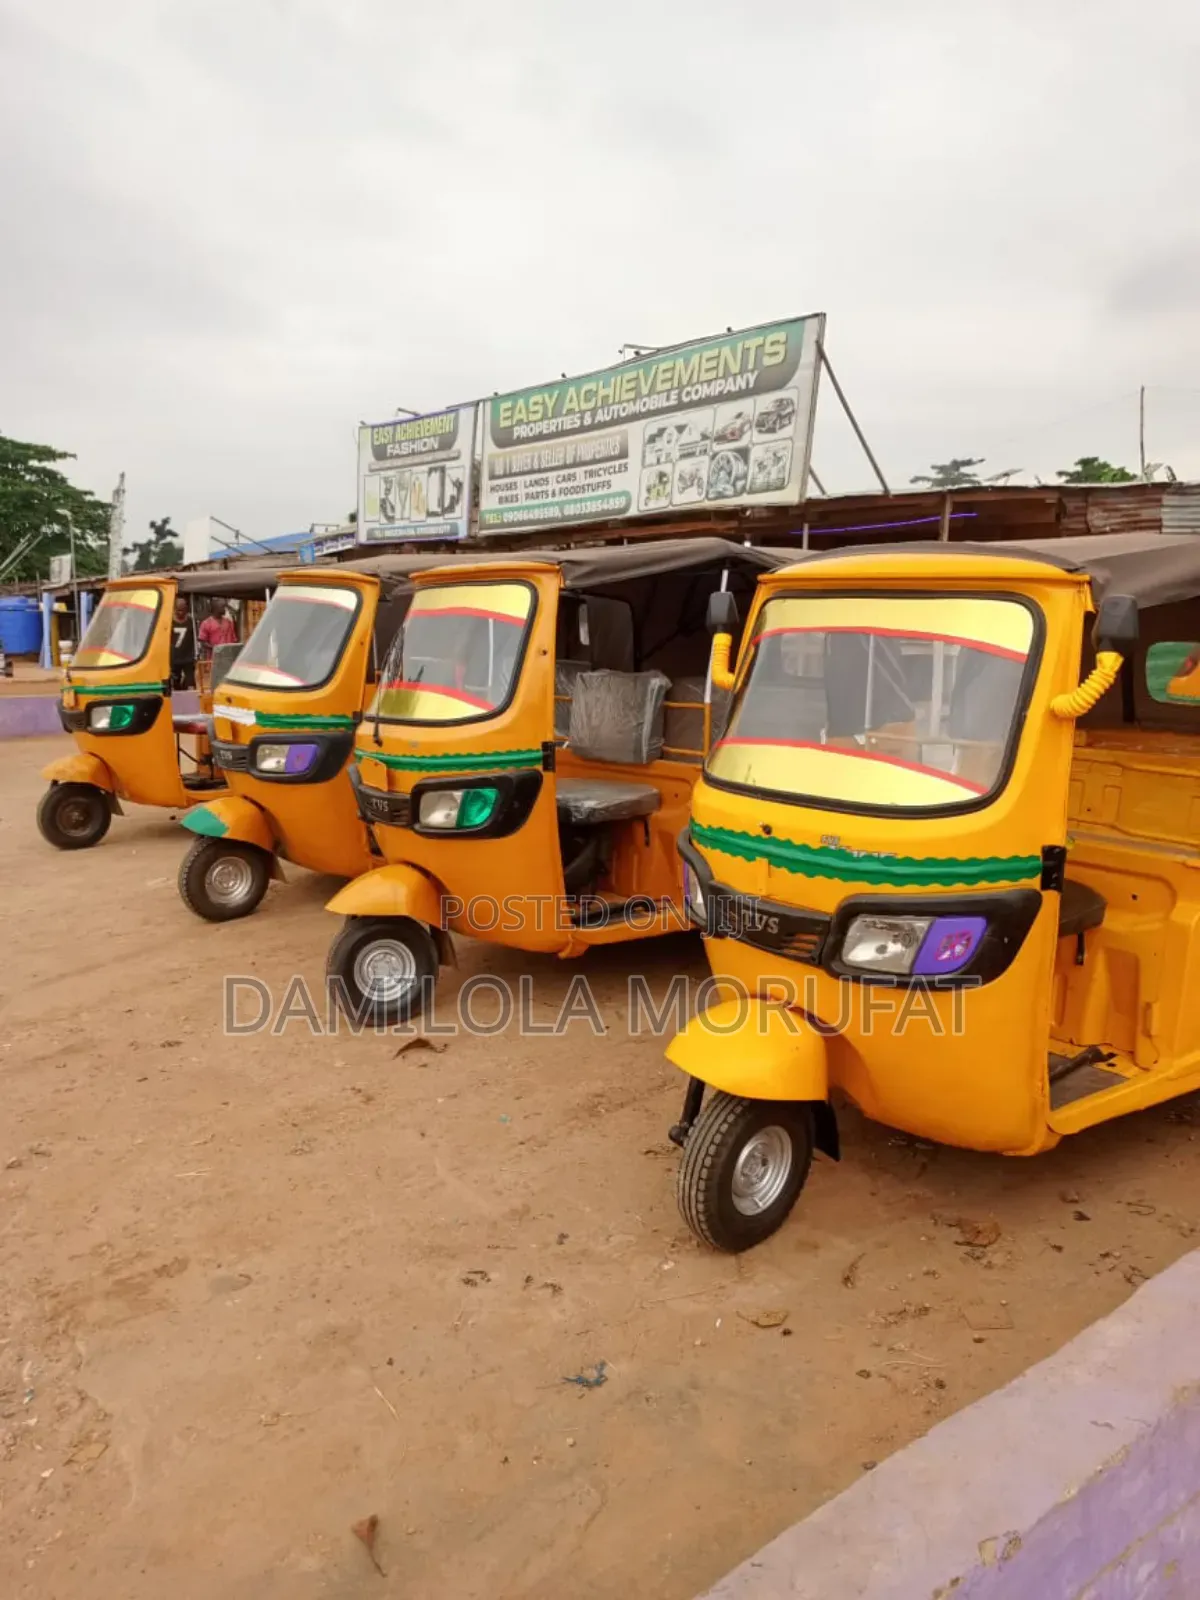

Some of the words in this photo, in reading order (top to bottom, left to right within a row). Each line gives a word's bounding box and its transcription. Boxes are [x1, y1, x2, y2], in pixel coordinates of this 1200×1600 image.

[499, 390, 560, 428] EASY
[563, 331, 788, 415] ACHIEVEMENTS
[513, 412, 581, 440] PROPERTIES
[583, 411, 593, 426] &
[594, 387, 679, 423] AUTOMOBILE
[681, 370, 760, 402] COMPANY
[373, 424, 393, 446] EASY
[386, 436, 440, 457] FASHION
[489, 481, 518, 493] HOUSES
[524, 476, 550, 489] LANDS
[555, 472, 577, 484] CARS
[584, 462, 629, 480] TRICYCLES
[498, 493, 519, 505] BIKES
[524, 489, 549, 501] PARTS
[551, 487, 557, 498] &
[559, 480, 612, 497] FOODSTUFFS
[173, 627, 187, 648] 7
[372, 797, 389, 812] TVS
